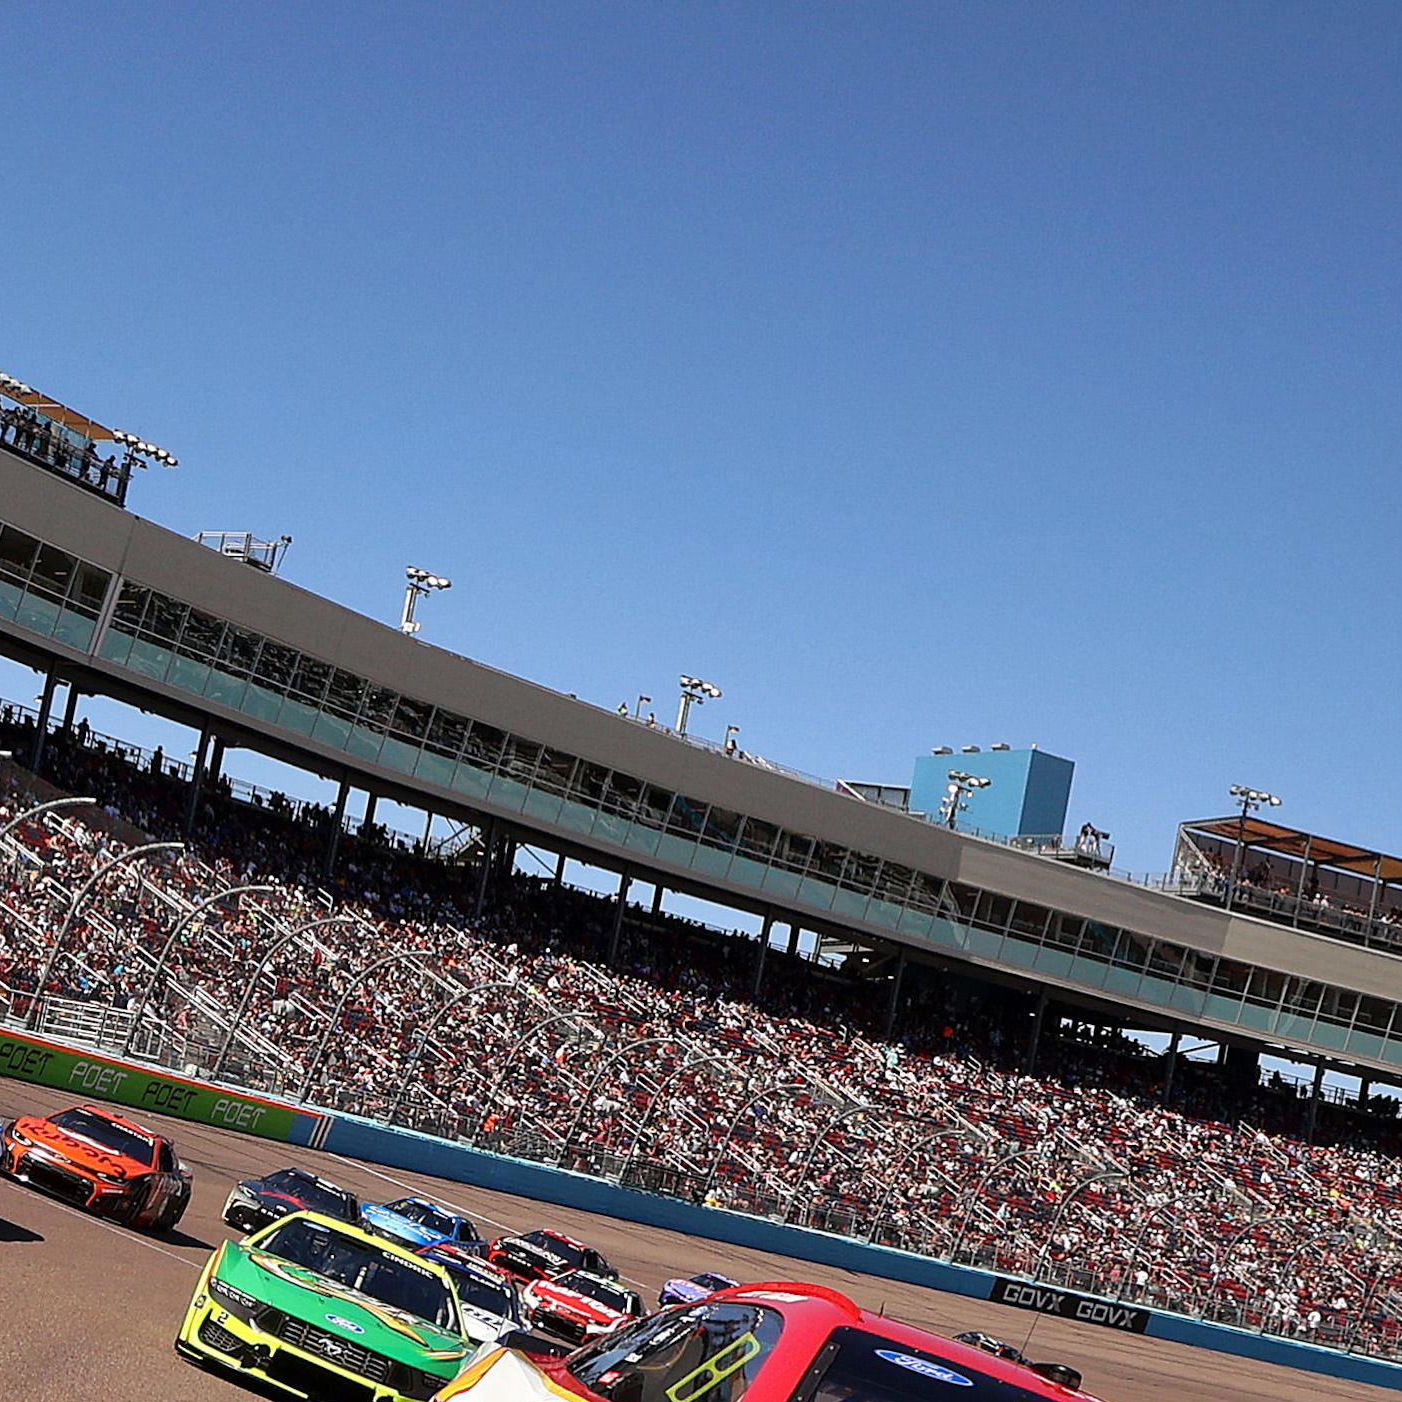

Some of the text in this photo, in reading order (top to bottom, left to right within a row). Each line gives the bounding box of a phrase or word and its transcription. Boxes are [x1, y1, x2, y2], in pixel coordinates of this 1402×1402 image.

[68, 1060, 128, 1095] POET
[142, 1081, 198, 1113] POET
[210, 1099, 266, 1129] POET
[382, 1251, 434, 1280] CINDRIC
[1003, 1284, 1065, 1313] GOVX
[217, 1312, 228, 1325] 2
[1076, 1301, 1138, 1329] GOVX
